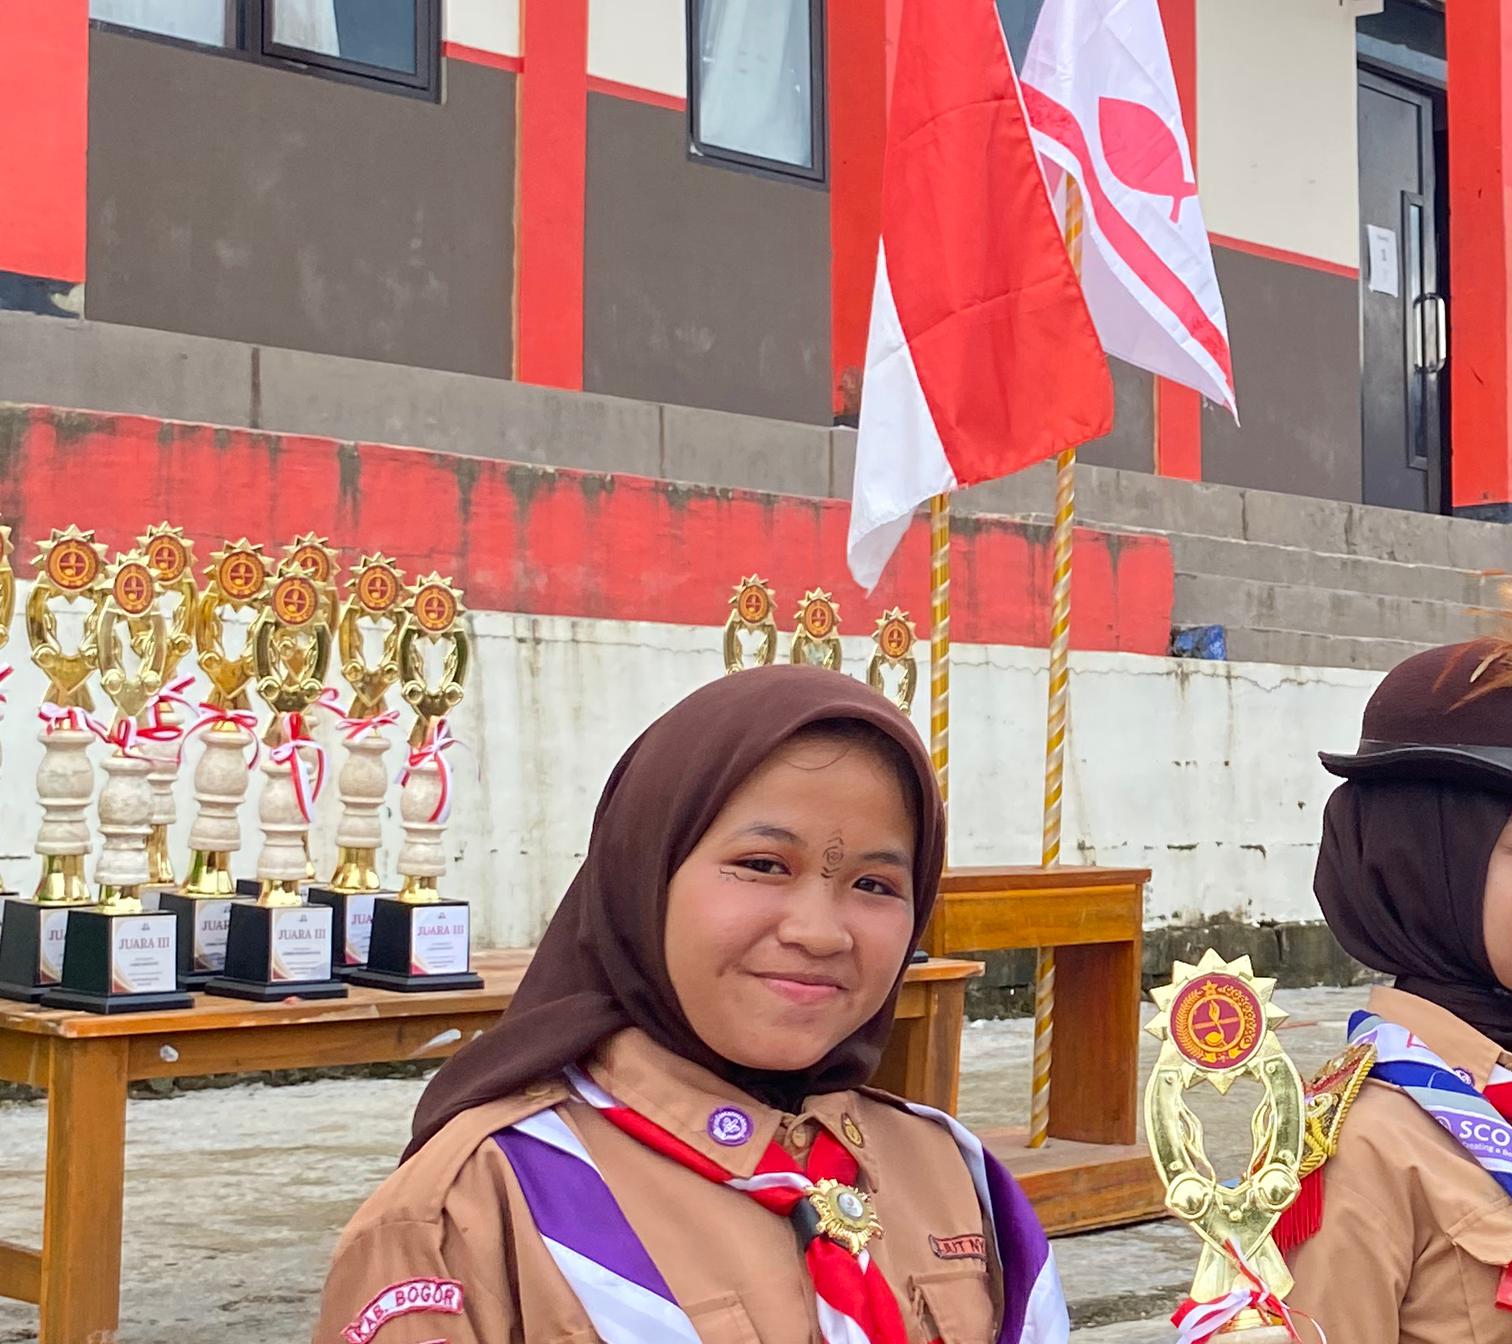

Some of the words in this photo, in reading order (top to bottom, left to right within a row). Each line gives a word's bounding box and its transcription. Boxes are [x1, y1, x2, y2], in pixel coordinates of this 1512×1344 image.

[278, 929, 312, 941] JUARA
[417, 926, 451, 937] JUARA
[118, 937, 155, 951] JUARA
[157, 937, 170, 949] III
[353, 1304, 390, 1343] KAB.
[394, 1284, 456, 1307] BOGOR
